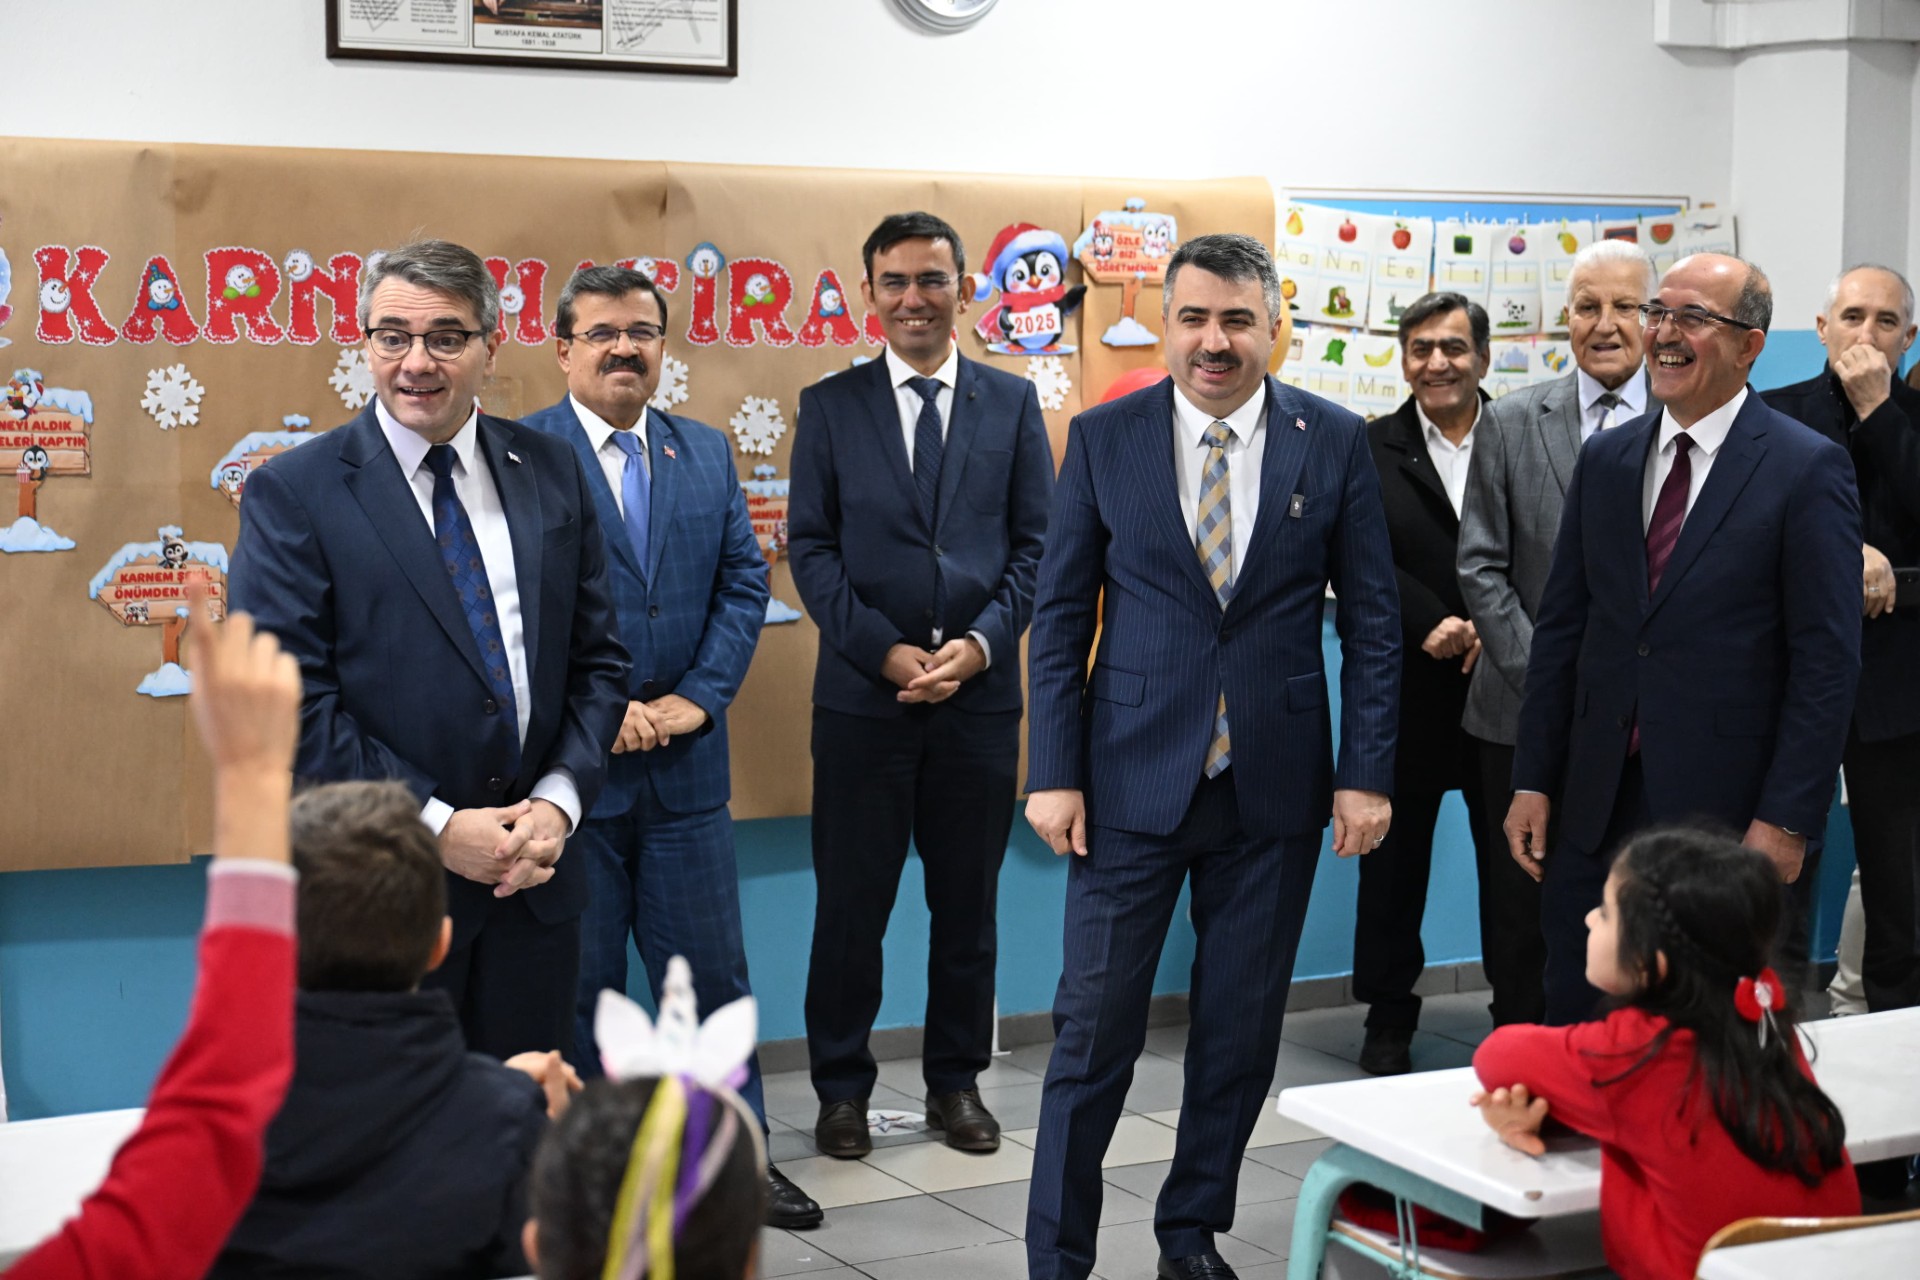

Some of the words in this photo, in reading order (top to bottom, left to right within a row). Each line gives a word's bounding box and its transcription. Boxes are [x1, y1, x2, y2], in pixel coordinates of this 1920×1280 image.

[494, 29, 525, 37] MUSTAFA
[527, 30, 550, 38] KEMAL
[552, 31, 582, 40] ATATÜRK
[33, 245, 388, 346] KARN
[1015, 313, 1055, 334] 2025
[32, 420, 72, 431] ALDIK
[38, 436, 86, 448] KAPTIK
[120, 571, 174, 584] KARNEM
[115, 585, 179, 600] ÖNÜMDEN
